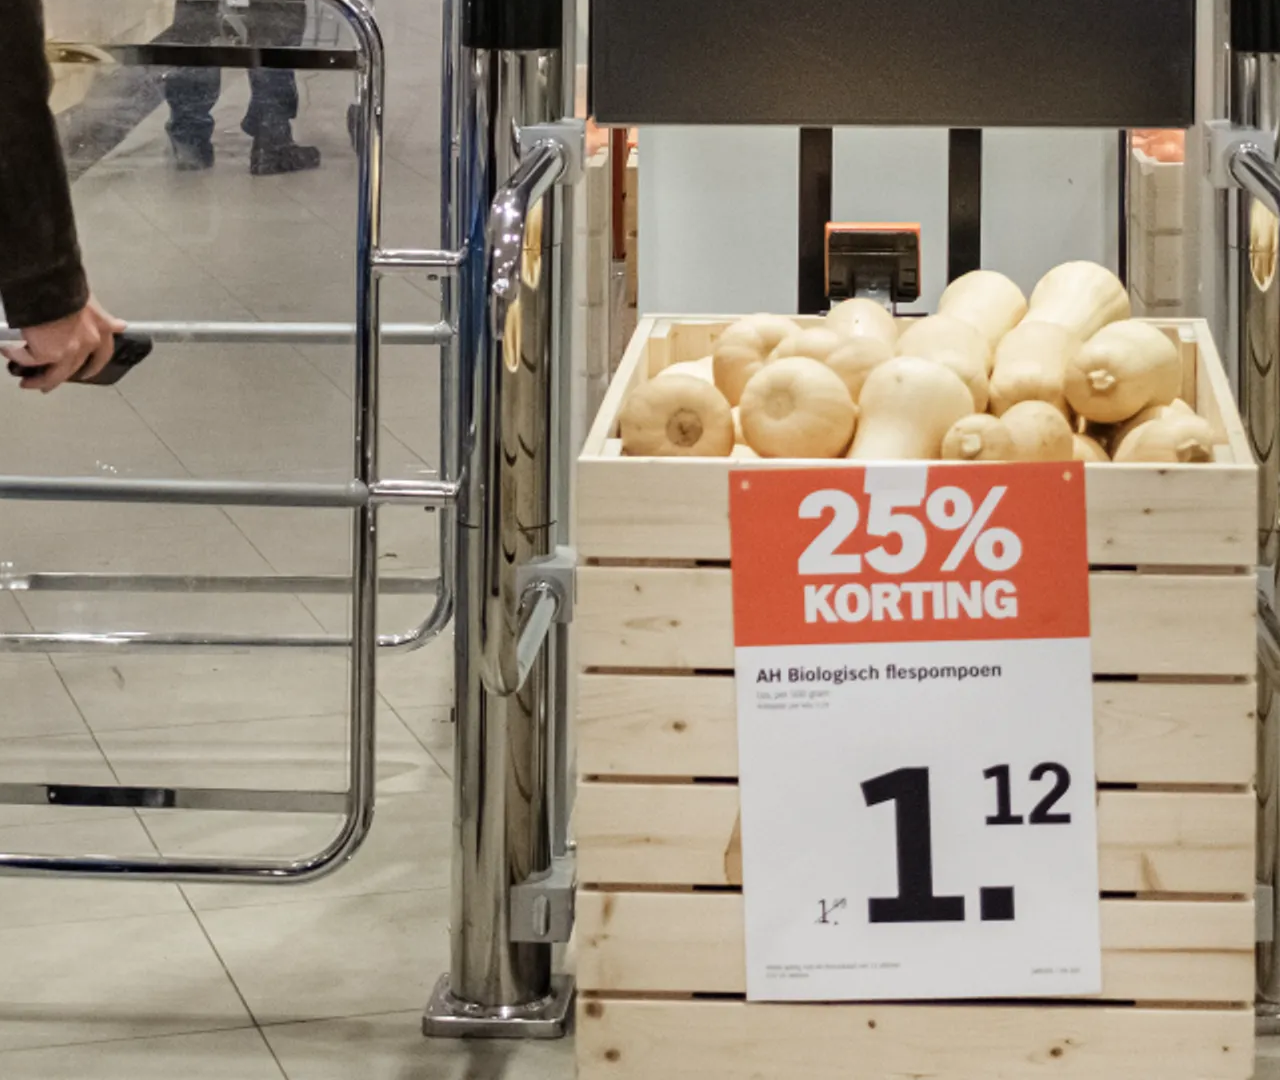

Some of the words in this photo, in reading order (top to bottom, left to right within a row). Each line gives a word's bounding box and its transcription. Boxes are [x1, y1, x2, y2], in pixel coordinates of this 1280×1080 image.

[797, 485, 1022, 576] 25%
[803, 580, 1018, 624] KORTING
[756, 668, 782, 684] AH
[788, 665, 880, 685] Biologisch
[885, 663, 1002, 681] flespompoen
[861, 761, 1072, 925] 1.12
